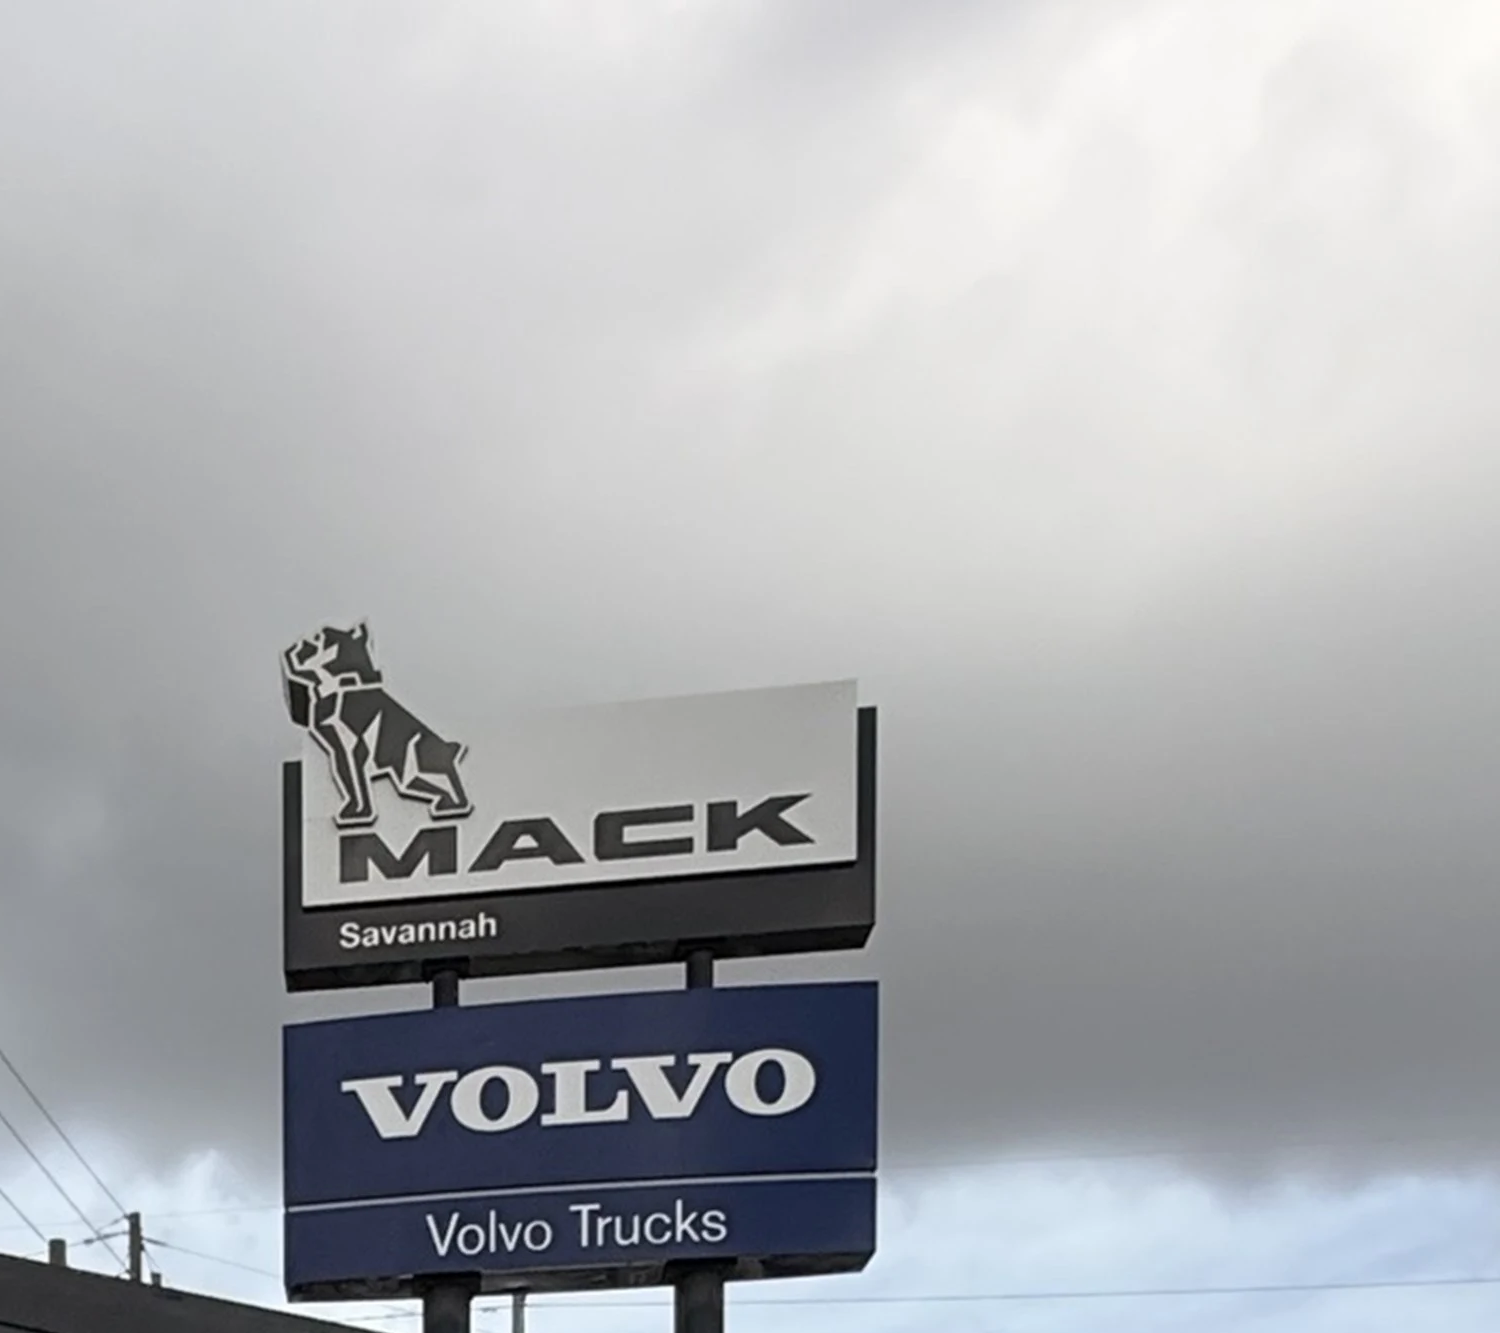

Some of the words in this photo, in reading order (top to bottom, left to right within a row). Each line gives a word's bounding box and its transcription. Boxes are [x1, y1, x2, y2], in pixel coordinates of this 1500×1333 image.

[339, 793, 816, 883] MACK
[339, 912, 497, 949] Savannah
[341, 1048, 816, 1139] VOLVO
[426, 1210, 553, 1256] Volvo
[569, 1200, 728, 1247] Trucks
